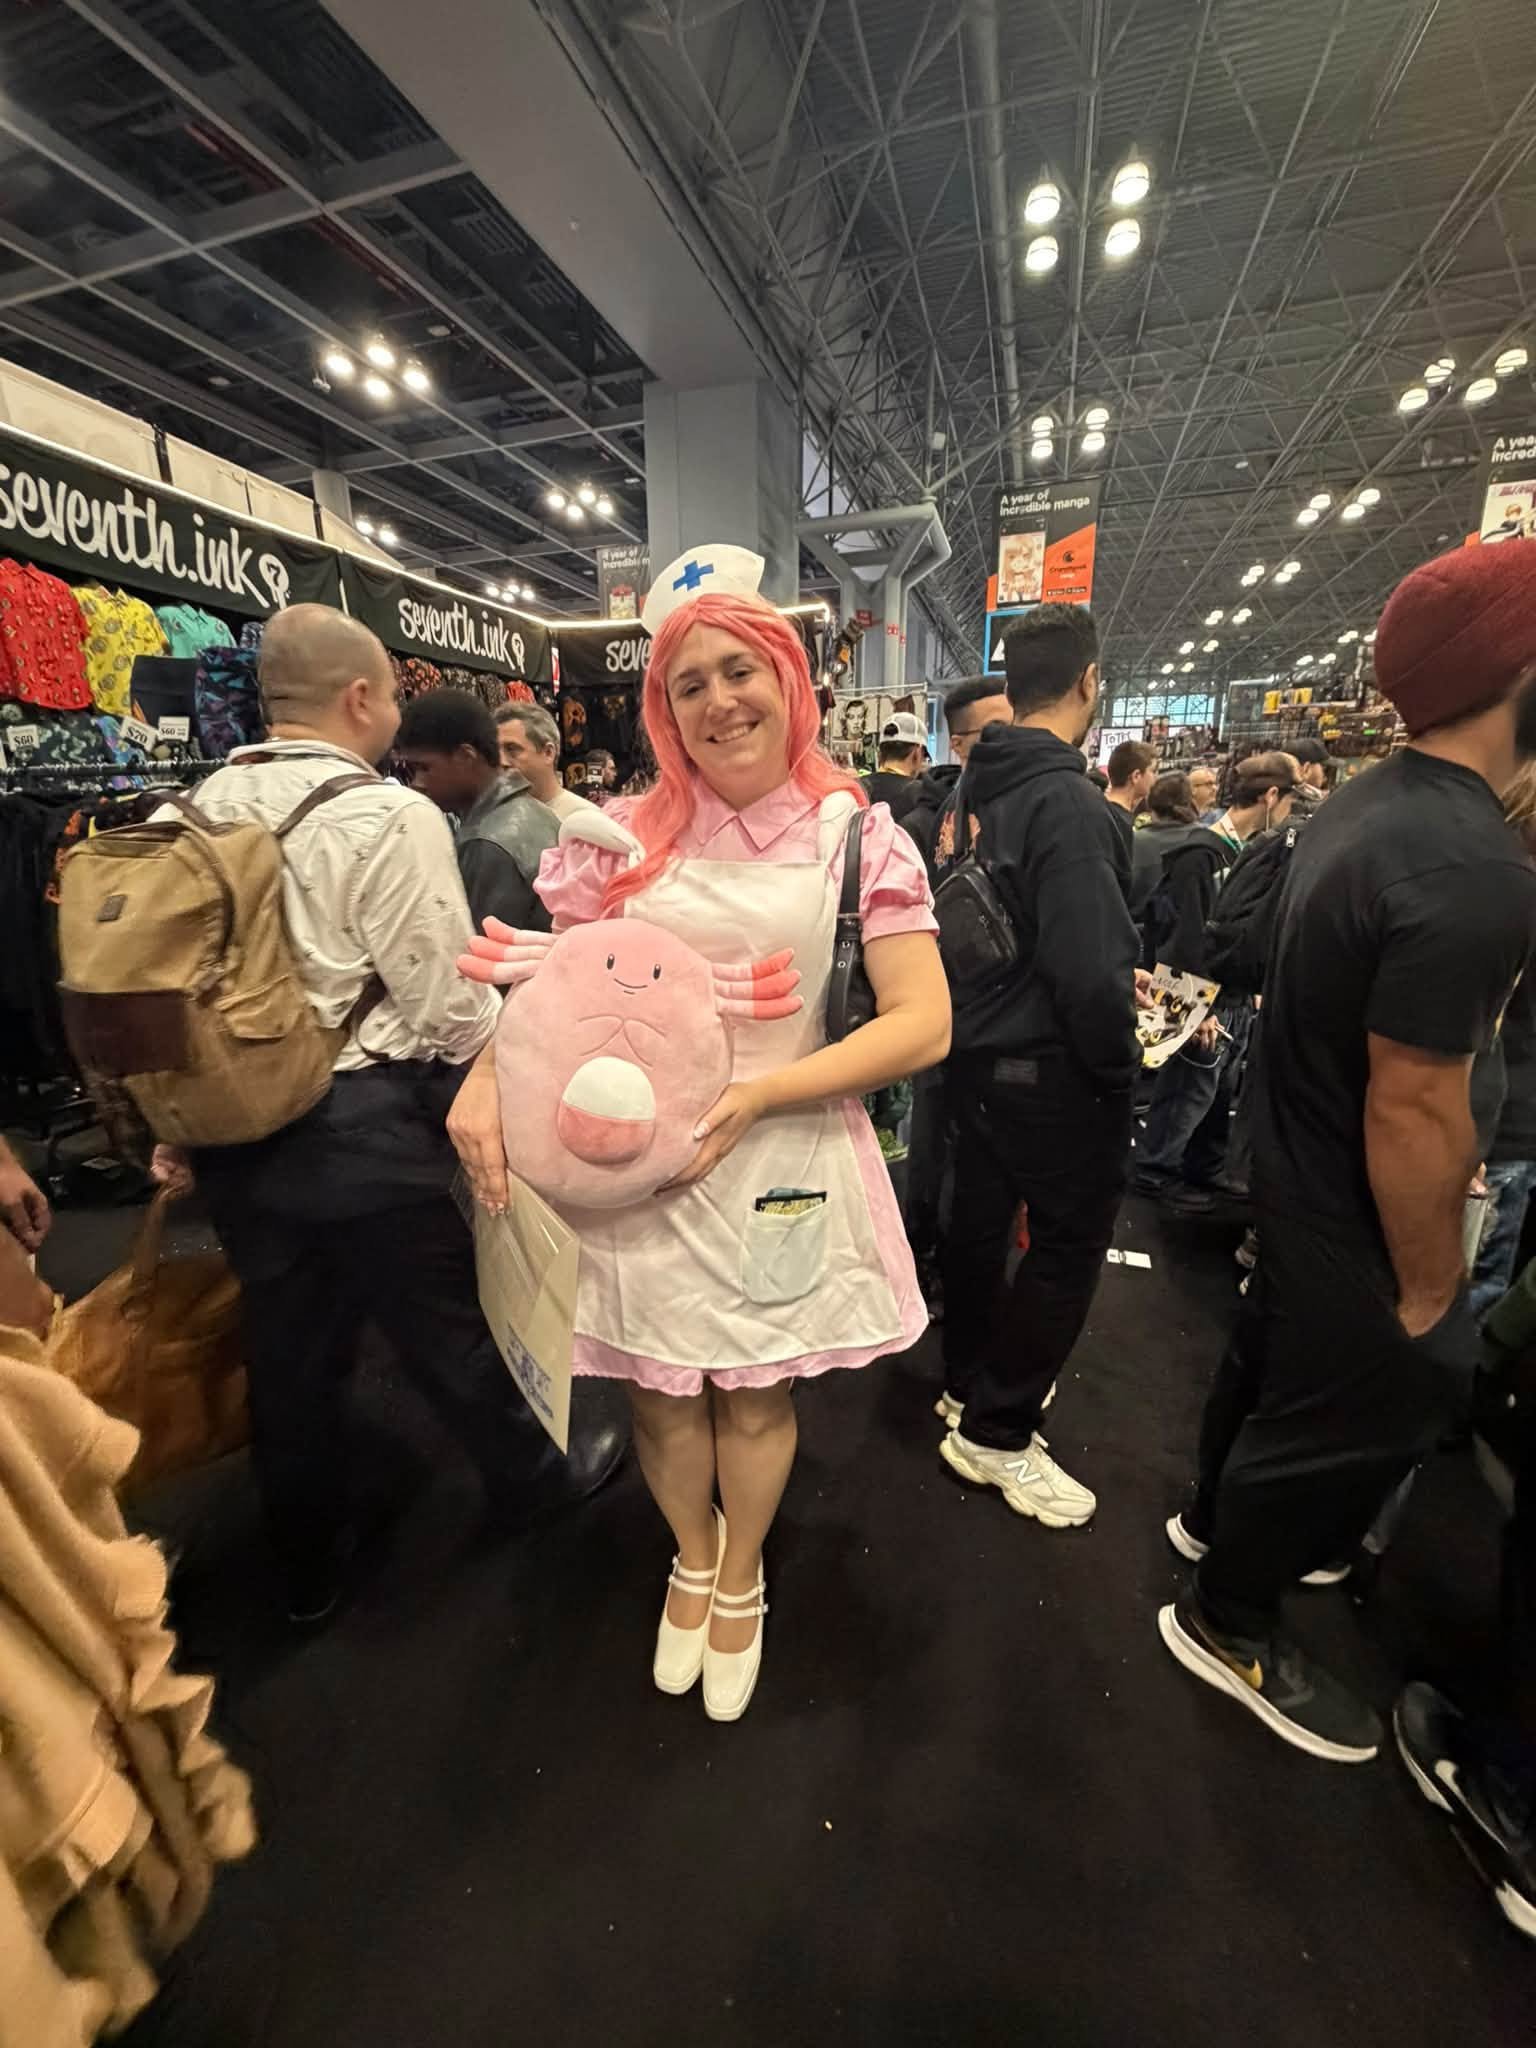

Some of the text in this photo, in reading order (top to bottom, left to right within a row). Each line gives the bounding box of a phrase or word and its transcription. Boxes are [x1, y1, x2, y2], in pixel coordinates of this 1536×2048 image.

[1494, 434, 1536, 450] A yea
[1001, 488, 1050, 505] A year of
[1054, 497, 1091, 511] manga
[398, 598, 515, 671] seventh.ink
[127, 726, 148, 743] $70
